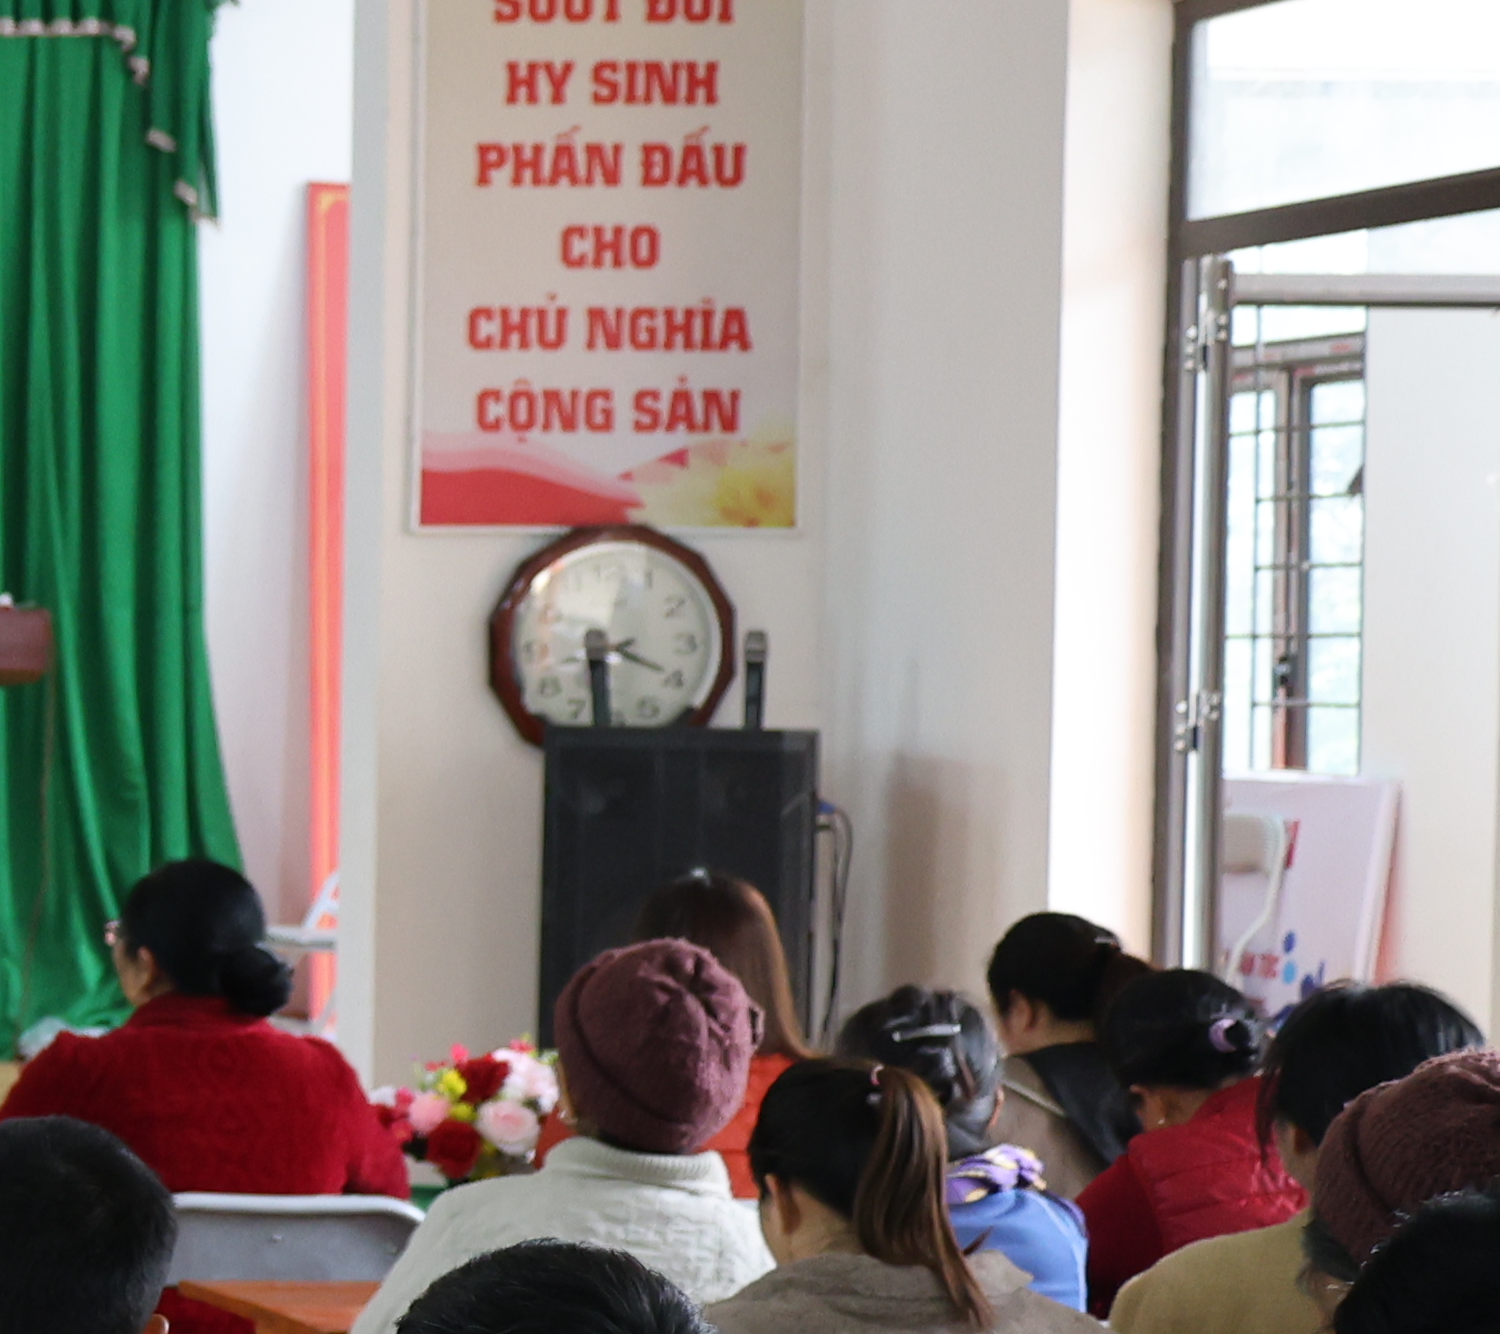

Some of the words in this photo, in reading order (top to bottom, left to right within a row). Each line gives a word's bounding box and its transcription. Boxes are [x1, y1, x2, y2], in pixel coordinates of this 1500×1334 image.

[505, 60, 576, 107] HY
[590, 59, 719, 107] SINH
[475, 126, 624, 189] PHẤN
[640, 126, 748, 189] ĐẤU
[560, 224, 661, 270] CHO
[467, 293, 569, 352] CHỦ
[585, 297, 753, 353] NGHĨA
[474, 379, 616, 444] CỘNG
[632, 375, 742, 435] SẢN
